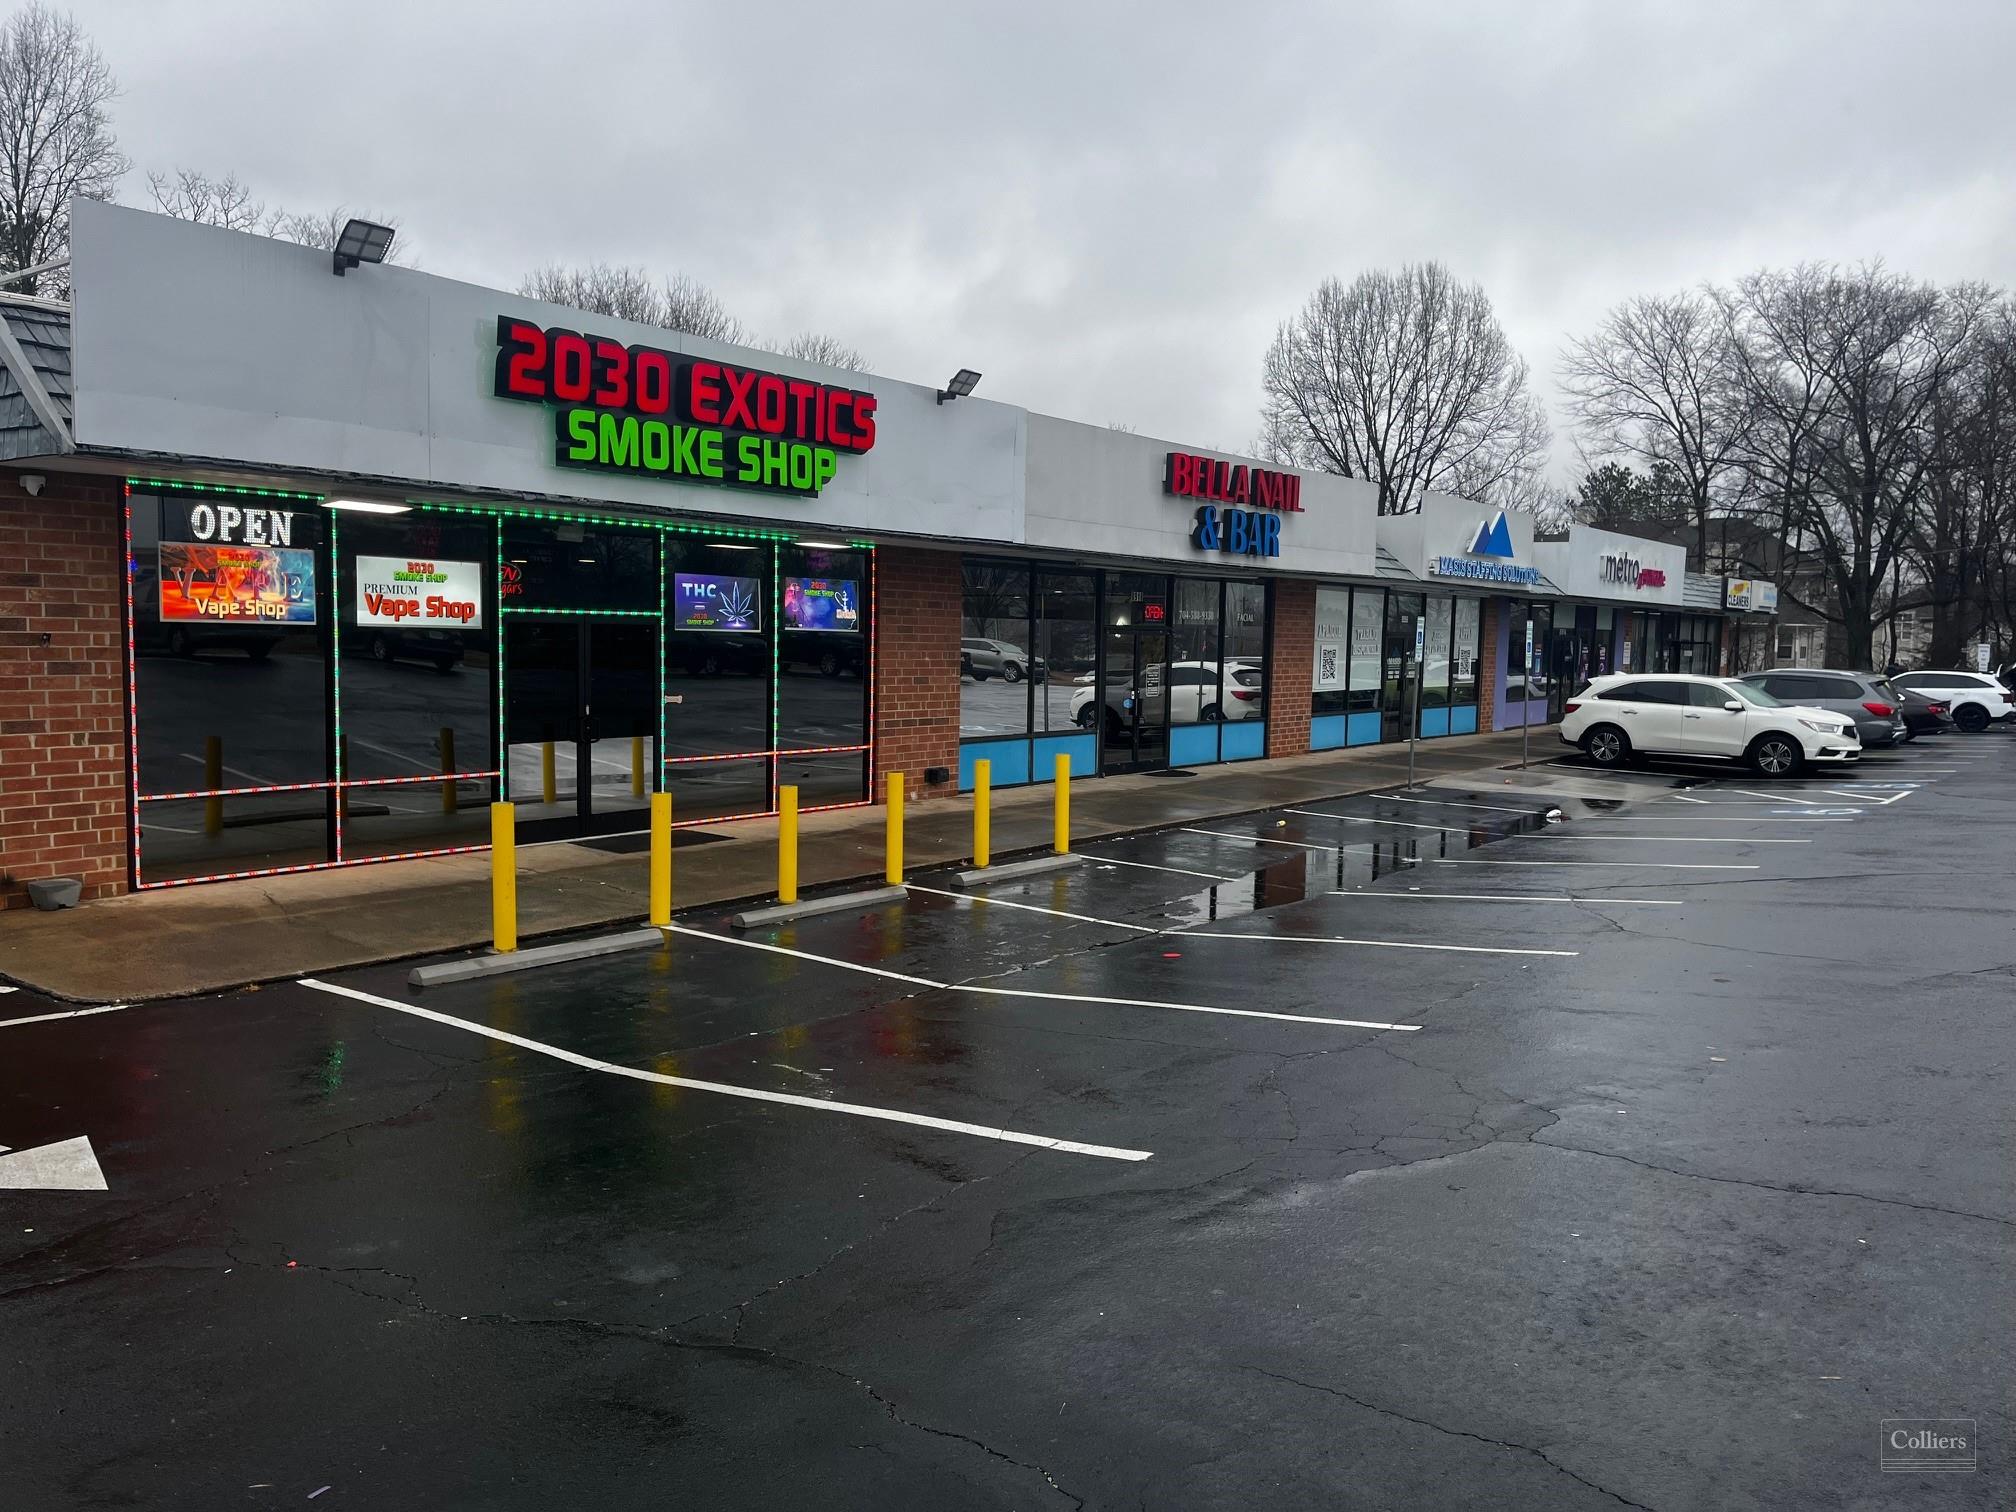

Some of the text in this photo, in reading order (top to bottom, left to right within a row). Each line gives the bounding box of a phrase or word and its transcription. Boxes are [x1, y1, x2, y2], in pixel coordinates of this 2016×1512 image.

[508, 323, 878, 450] 2030 EXOTICS
[568, 408, 837, 492] SMOKE SHOP
[1168, 453, 1305, 512] BELLA NAIL
[190, 504, 294, 546] OPEN
[1197, 505, 1281, 557] & BAR
[393, 570, 448, 584] SMOKE SHOP
[407, 562, 435, 574] 2030
[1605, 552, 1640, 582] metro
[170, 567, 305, 602] VAPE
[364, 583, 418, 596] PREMIUM
[681, 582, 717, 598] THC
[194, 597, 286, 619] Vape Shop
[365, 593, 476, 624] Vape Shop
